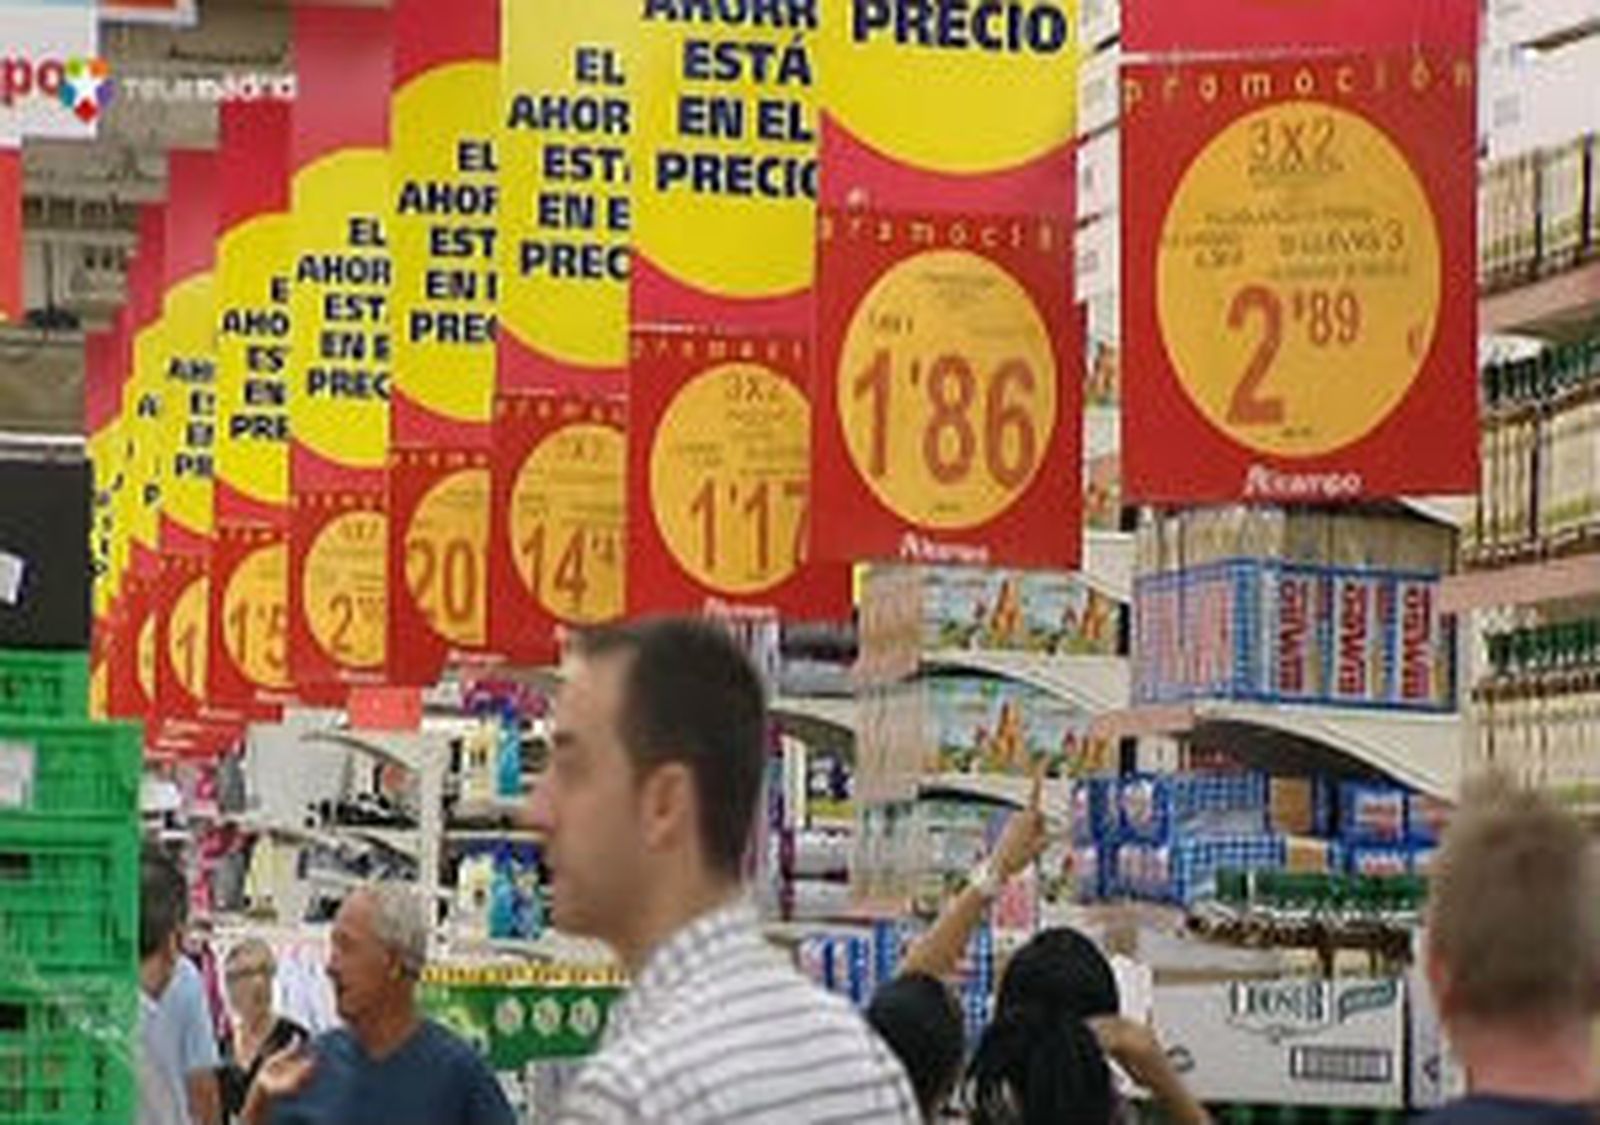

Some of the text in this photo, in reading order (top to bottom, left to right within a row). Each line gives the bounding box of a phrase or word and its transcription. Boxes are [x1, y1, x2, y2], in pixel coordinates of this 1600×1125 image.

[854, 0, 1068, 54] PRECIO
[576, 48, 624, 85] EL
[683, 33, 813, 86] ESTÁ
[508, 95, 630, 134] AHOR
[678, 97, 812, 142] EN EL
[458, 141, 497, 171] EL
[538, 195, 593, 229] EN
[349, 219, 385, 245] EL
[426, 271, 475, 299] EN
[321, 333, 364, 359] EN
[853, 350, 1036, 490] 1'86
